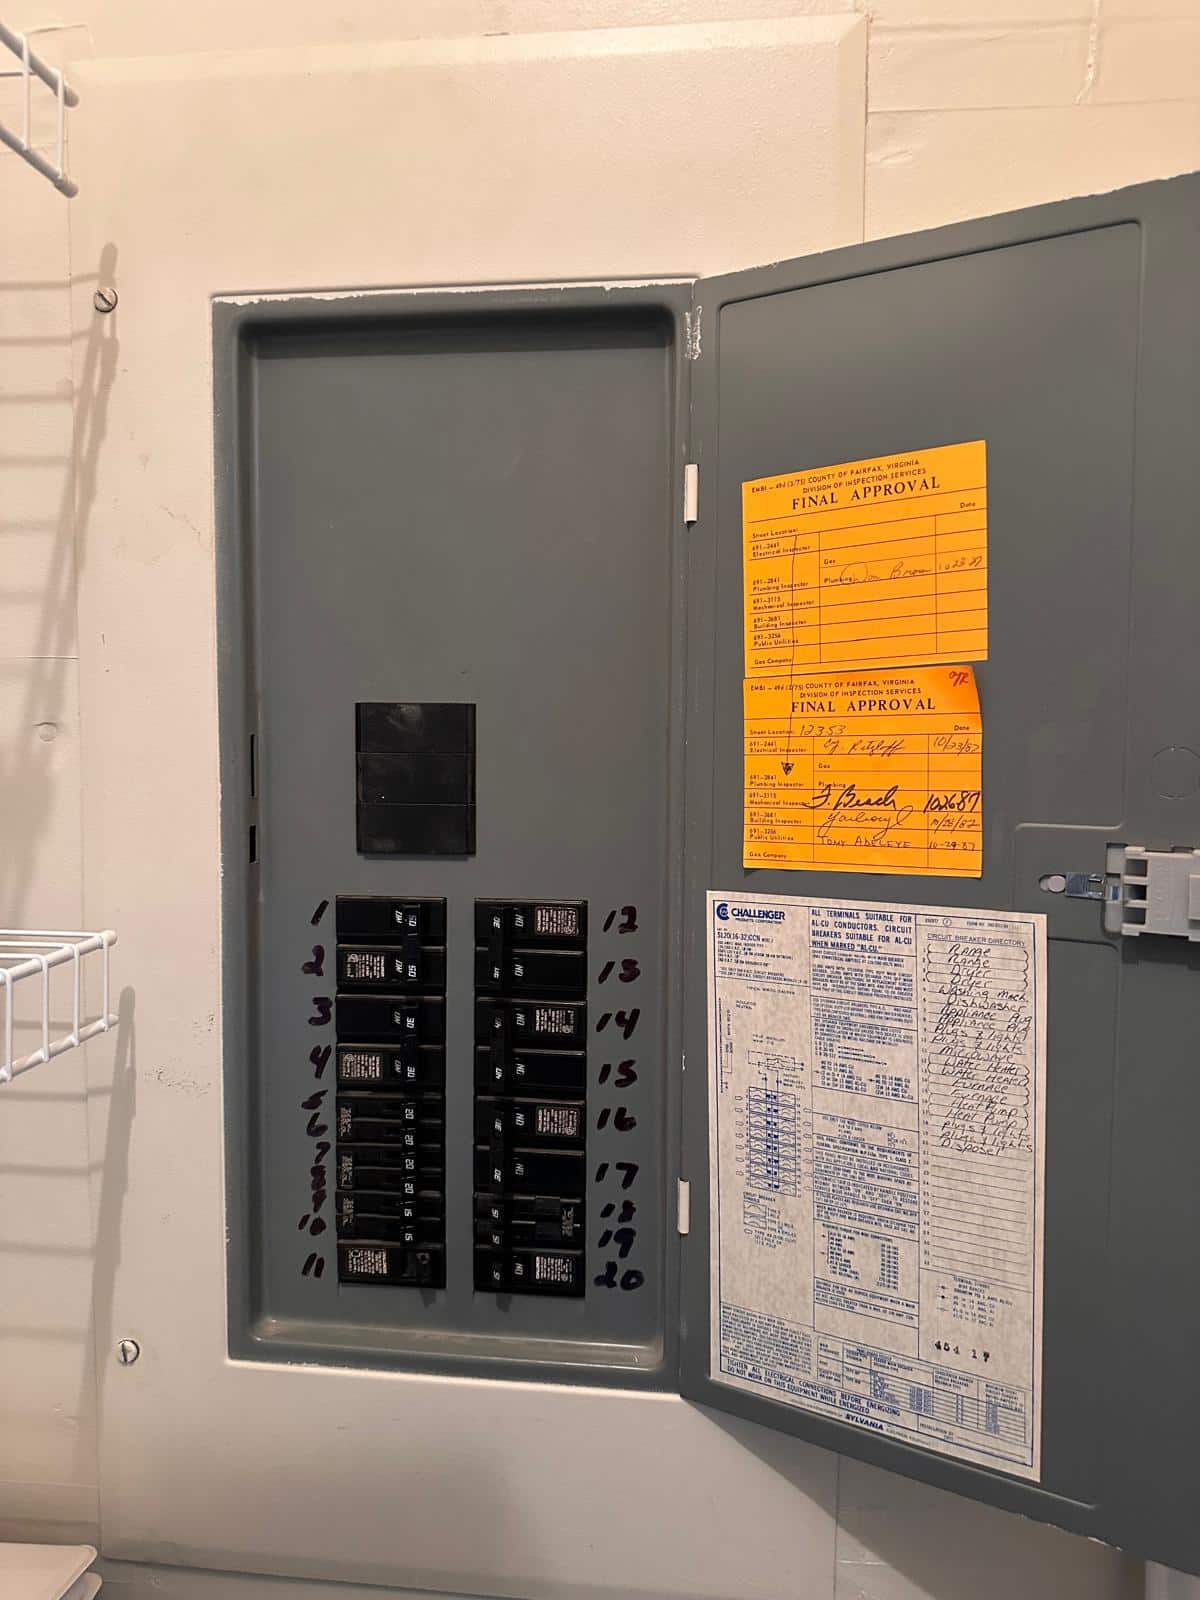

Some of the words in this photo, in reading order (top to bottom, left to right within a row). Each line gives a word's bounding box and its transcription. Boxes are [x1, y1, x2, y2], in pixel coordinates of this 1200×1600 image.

[803, 483, 831, 494] DIVISION
[833, 481, 843, 489] OF
[845, 473, 889, 487] INSPECTION
[890, 468, 927, 480] SERVICES
[808, 473, 835, 484] COUNTY
[838, 471, 847, 479] OF
[886, 459, 920, 470] VIRGINIA
[792, 492, 839, 510] FINAL
[850, 476, 941, 501] APPROVAL
[805, 682, 832, 690] COUNTY
[882, 678, 915, 686] VIRGINIA
[841, 689, 885, 698] INSPECTION
[885, 687, 922, 696] SERVICES
[791, 701, 836, 713] FINAL
[847, 698, 937, 712] APPROVAL
[799, 724, 847, 737] 12353
[311, 899, 329, 926] 1
[603, 905, 639, 935] 12
[731, 907, 786, 921] CHALLENGER
[811, 909, 822, 917] ALL
[826, 910, 860, 919] TERMINALS
[865, 912, 893, 922] SUITABLE
[899, 914, 913, 924] FOR
[811, 930, 842, 939] BREAKERS
[845, 932, 874, 942] SUITABLE
[878, 935, 890, 943] FOR
[894, 936, 913, 945] AL-CU
[884, 925, 913, 934] CIRCUIT
[927, 933, 953, 941] CIRCUIT
[955, 934, 987, 943] BREAKER
[988, 937, 1025, 947] DIRECTORY
[811, 940, 829, 948] WHEN
[830, 942, 856, 951] MARKED
[301, 944, 325, 977] 2
[598, 958, 641, 985] 13
[308, 996, 333, 1026] 3
[596, 1008, 641, 1040] 14
[309, 1044, 332, 1079] 4
[598, 1059, 638, 1089] 15
[306, 1111, 329, 1137] 6
[596, 1106, 638, 1132] 16
[314, 1141, 332, 1164] 7
[595, 1161, 640, 1190] 17
[598, 1227, 637, 1259] 19
[301, 1252, 325, 1278] 11
[593, 1260, 645, 1291] 20
[727, 1360, 749, 1371] TIGHTEN
[751, 1363, 761, 1374] ALL
[764, 1369, 795, 1384] ELECTRICAL
[799, 1380, 837, 1397] CONNECTIONS
[840, 1391, 862, 1405] BEFORE
[866, 1399, 901, 1417] ENERGIZING
[727, 1365, 736, 1374] DO
[736, 1367, 747, 1377] NOT
[748, 1370, 763, 1382] WORK
[764, 1375, 773, 1385] ON
[774, 1377, 787, 1389] THIS
[787, 1382, 819, 1399] EQUIPMENT
[820, 1392, 837, 1404] WHILE
[839, 1399, 870, 1415] ENERGIZED
[845, 1413, 884, 1431] SYLVANIA
